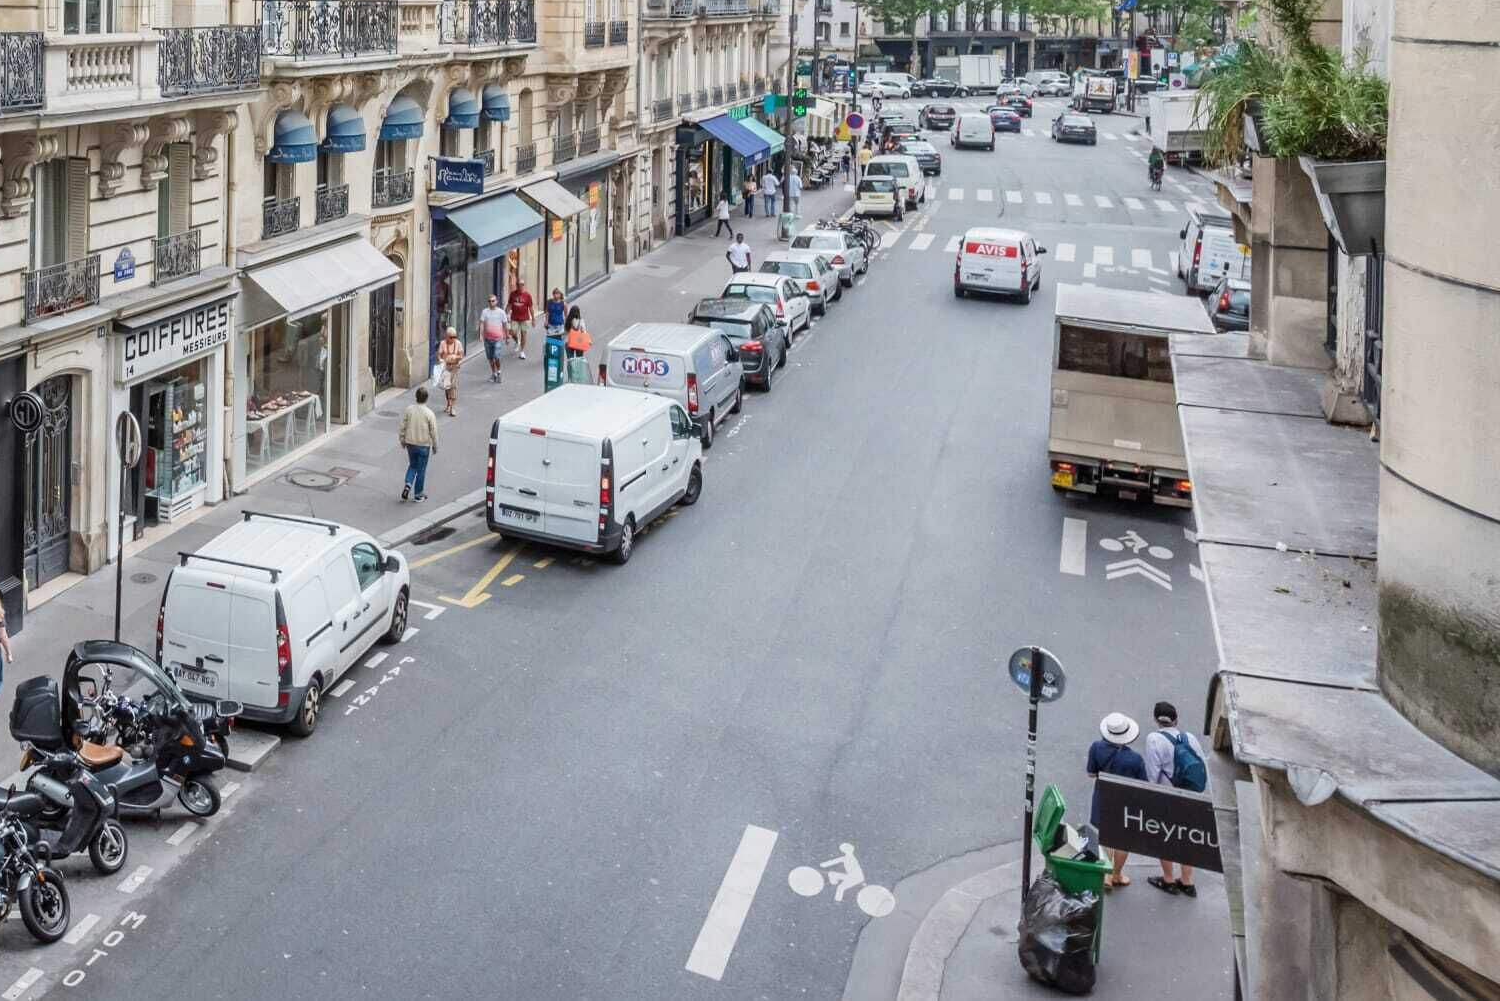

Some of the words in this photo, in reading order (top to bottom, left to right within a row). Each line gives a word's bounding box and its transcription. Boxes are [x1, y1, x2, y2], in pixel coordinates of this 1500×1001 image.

[975, 244, 1007, 256] AVIS
[125, 303, 227, 361] COIFFURES
[183, 330, 227, 355] MESSIEURS
[551, 345, 558, 355] P
[126, 365, 134, 378] 14
[624, 358, 666, 376] MMS
[345, 656, 414, 715] PAYANT
[63, 911, 147, 987] MOTO
